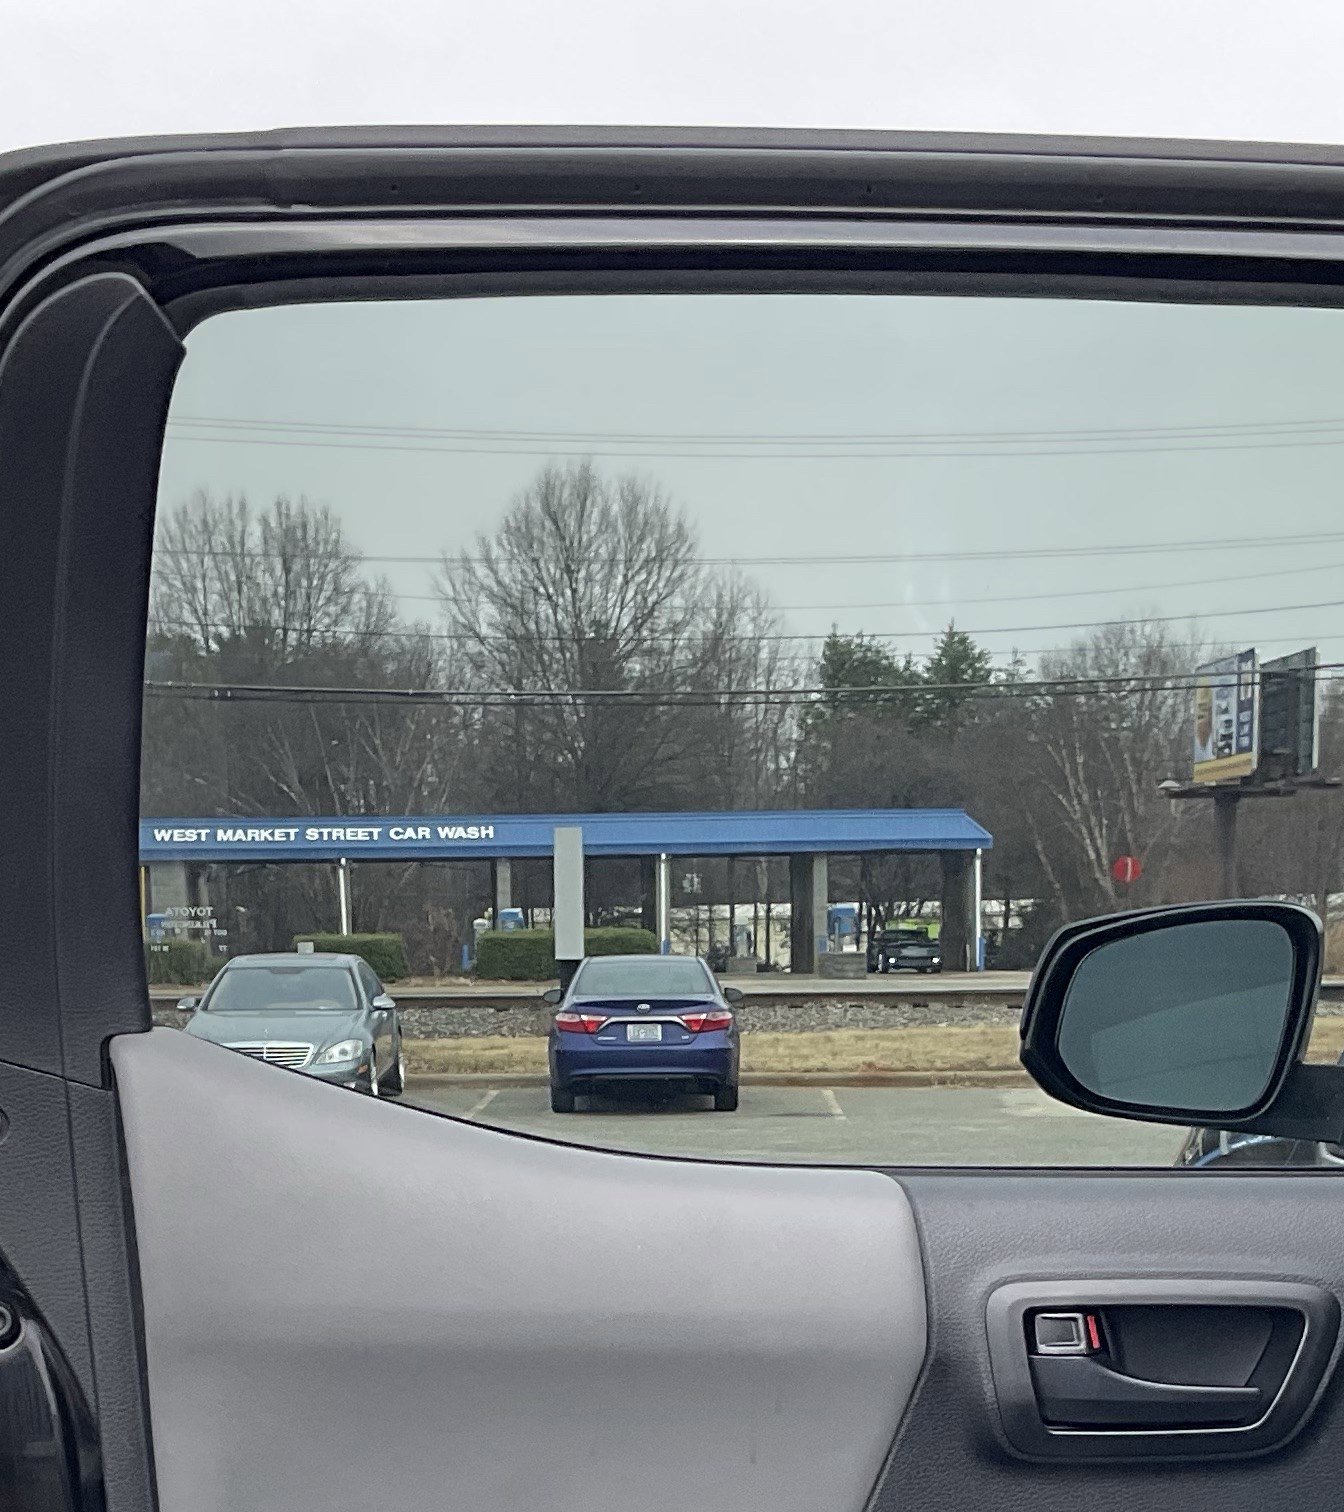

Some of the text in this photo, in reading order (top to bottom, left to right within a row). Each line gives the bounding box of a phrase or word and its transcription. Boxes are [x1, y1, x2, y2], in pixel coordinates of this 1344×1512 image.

[154, 826, 494, 842] WEST MARKET STREET CAR WASH
